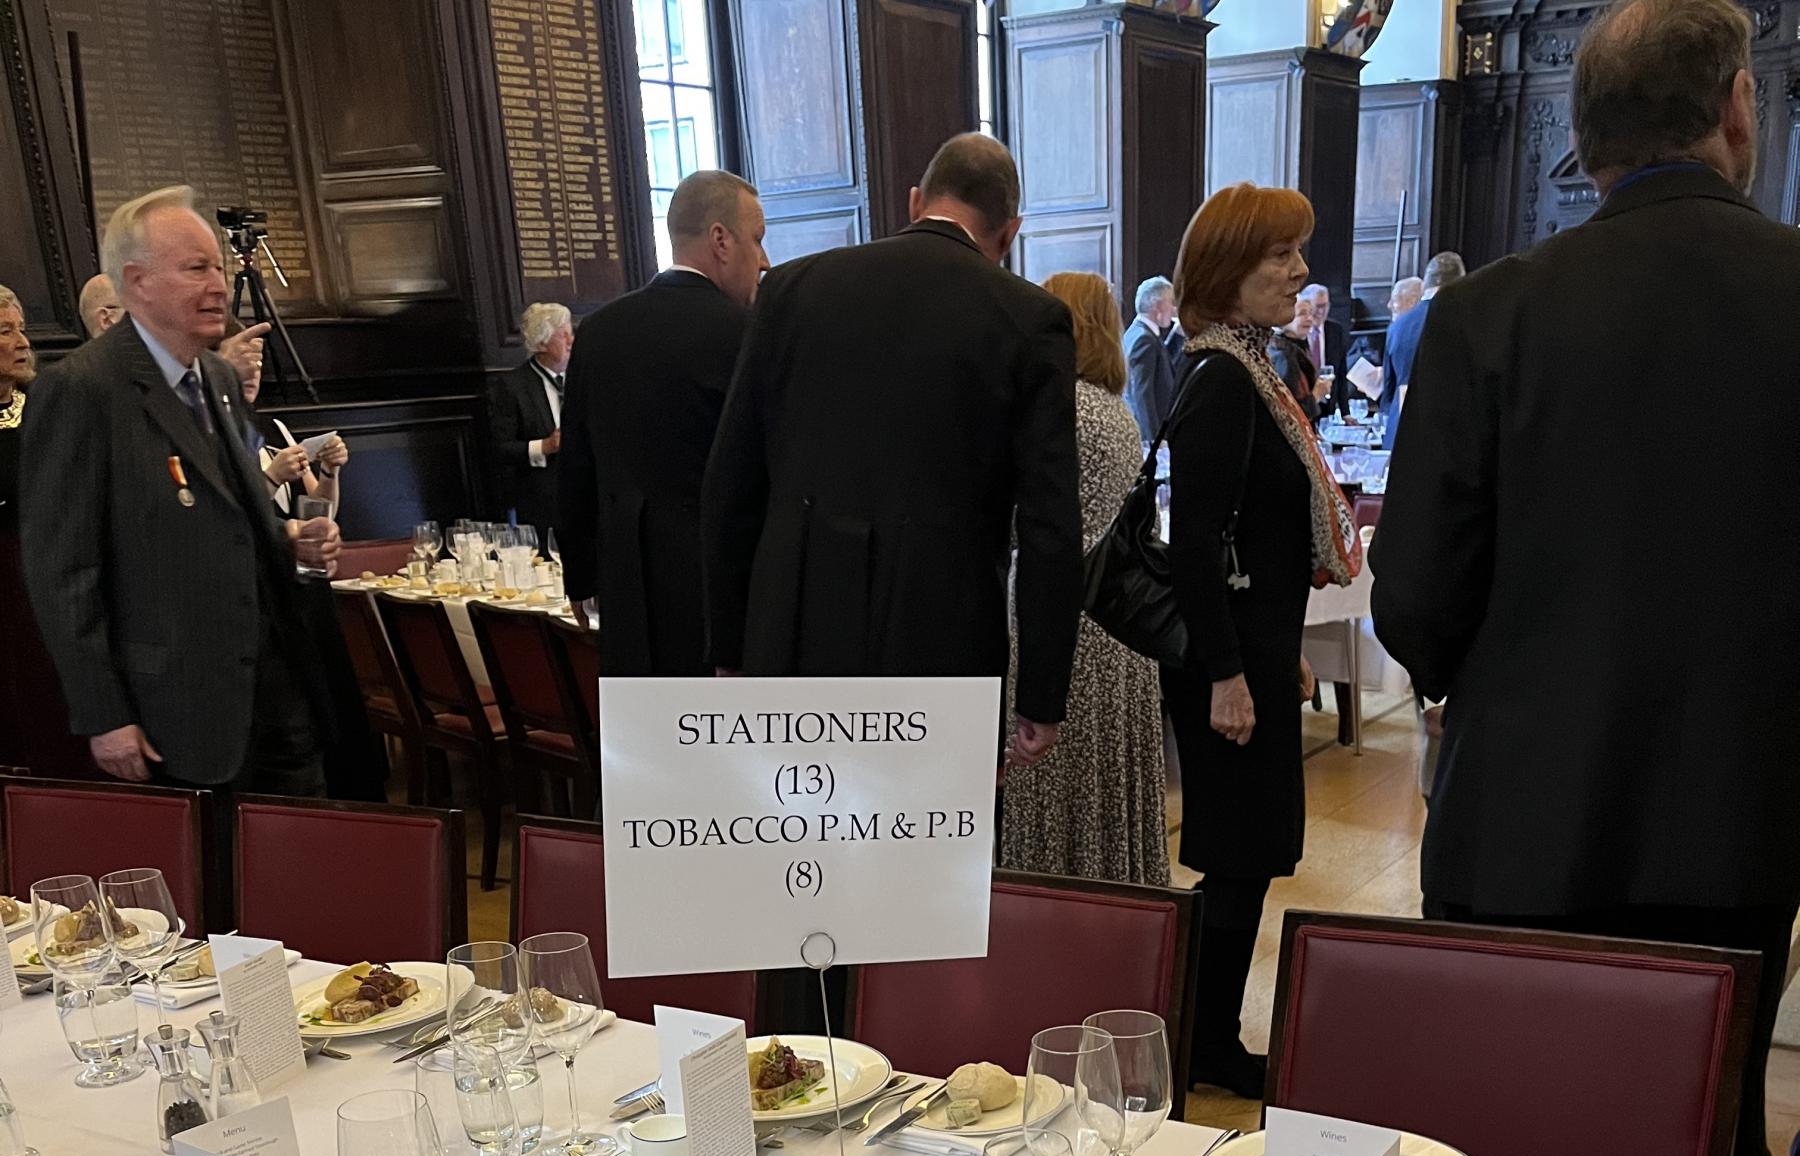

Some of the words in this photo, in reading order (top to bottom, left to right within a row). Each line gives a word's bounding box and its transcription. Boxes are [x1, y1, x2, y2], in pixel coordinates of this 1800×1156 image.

[678, 711, 927, 745] STATIONERS
[774, 763, 835, 806] (13)
[622, 815, 808, 849] TOBACCO
[817, 813, 881, 842] P.M
[891, 812, 917, 840] &
[926, 810, 975, 839] P.B
[785, 860, 823, 898] (8)
[223, 1126, 246, 1138] Menu
[1320, 1130, 1347, 1143] Wines
